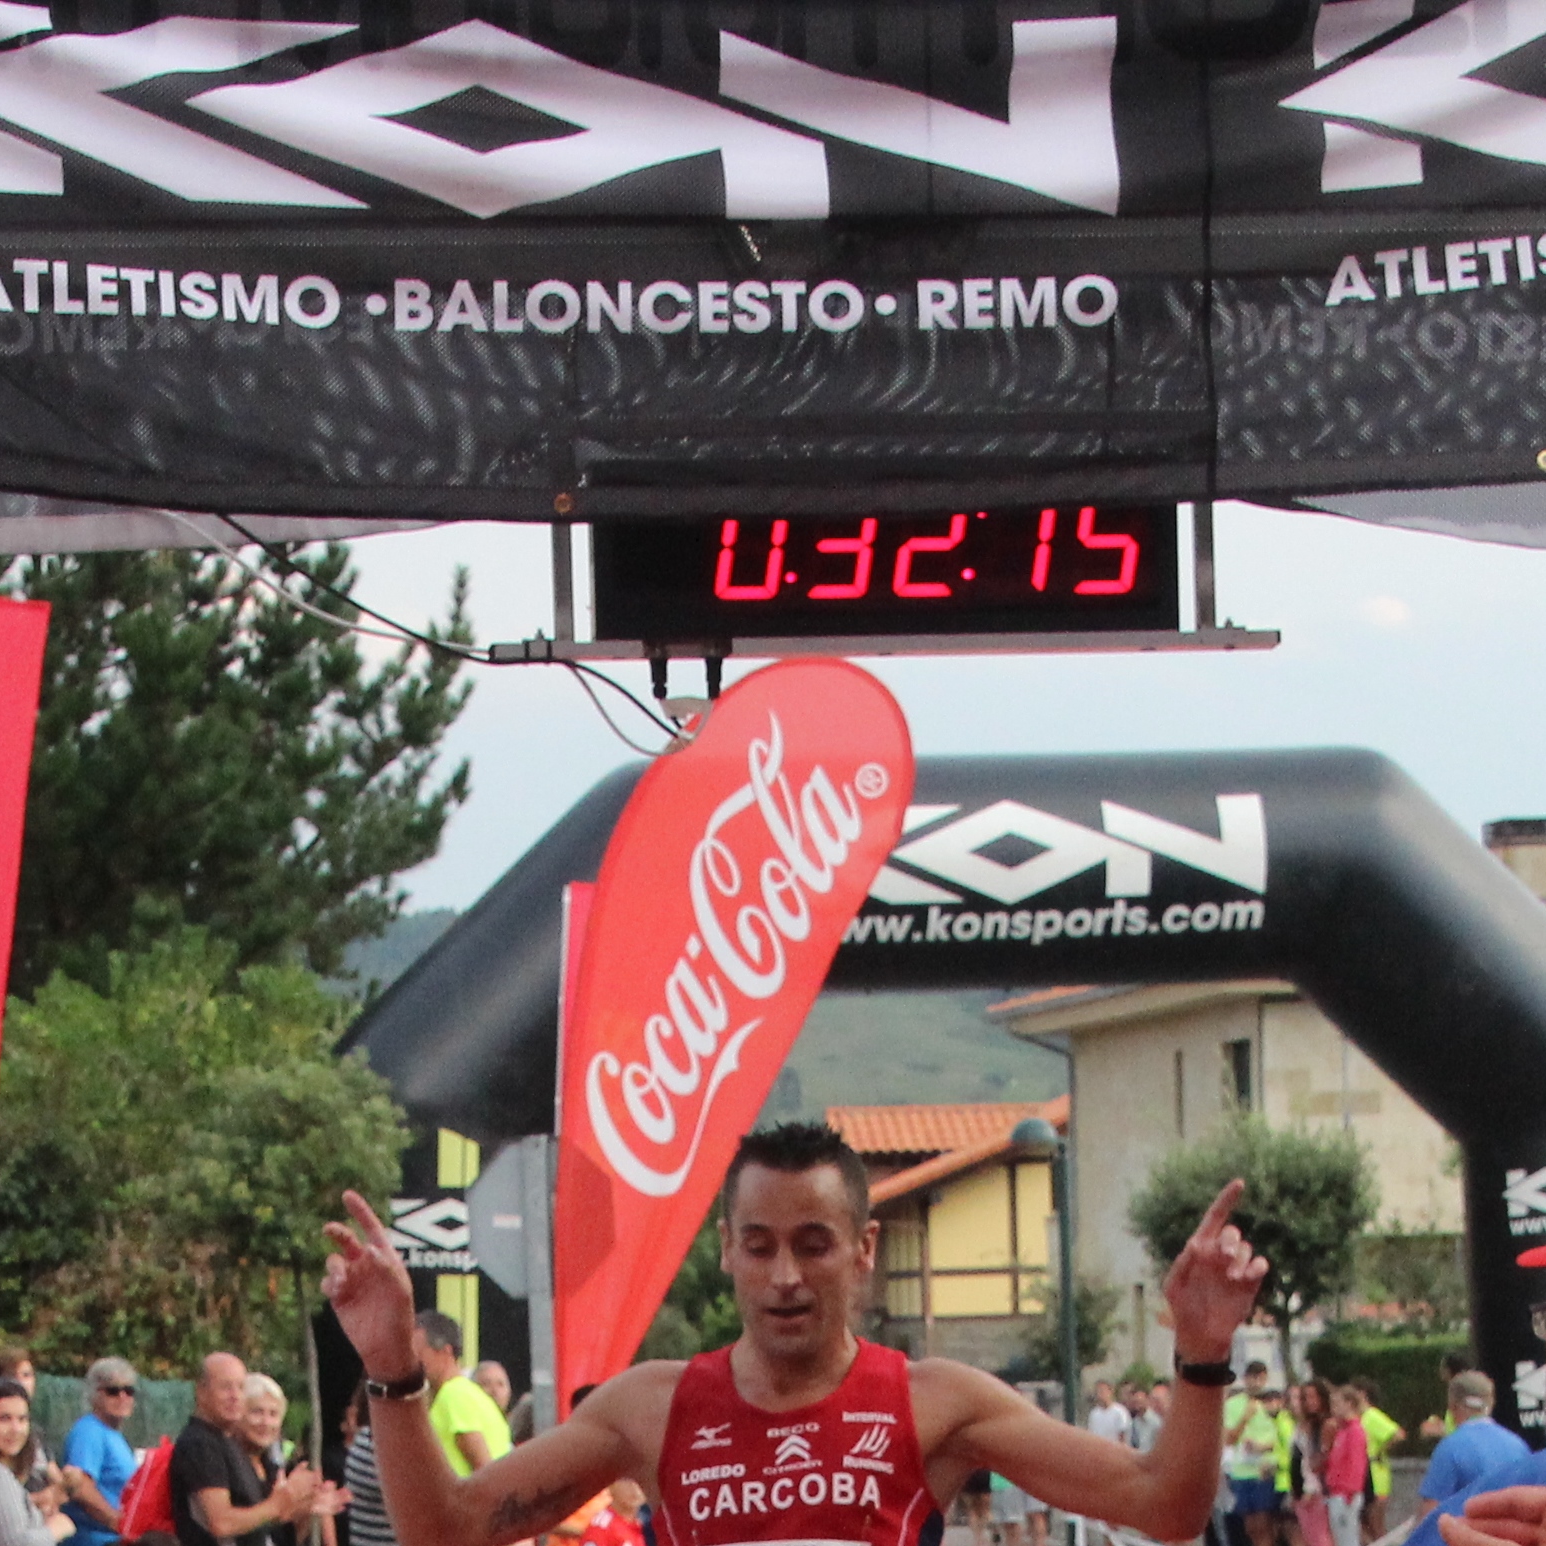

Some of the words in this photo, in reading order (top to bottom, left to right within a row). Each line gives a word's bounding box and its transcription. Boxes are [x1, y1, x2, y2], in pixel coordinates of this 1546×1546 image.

[394, 279, 865, 334] BALONCESTO
[917, 274, 1119, 331] REMO
[586, 708, 864, 1197] Coca-Cola
[681, 1463, 747, 1486] LOREDO
[689, 1472, 882, 1522] CARCOBA
